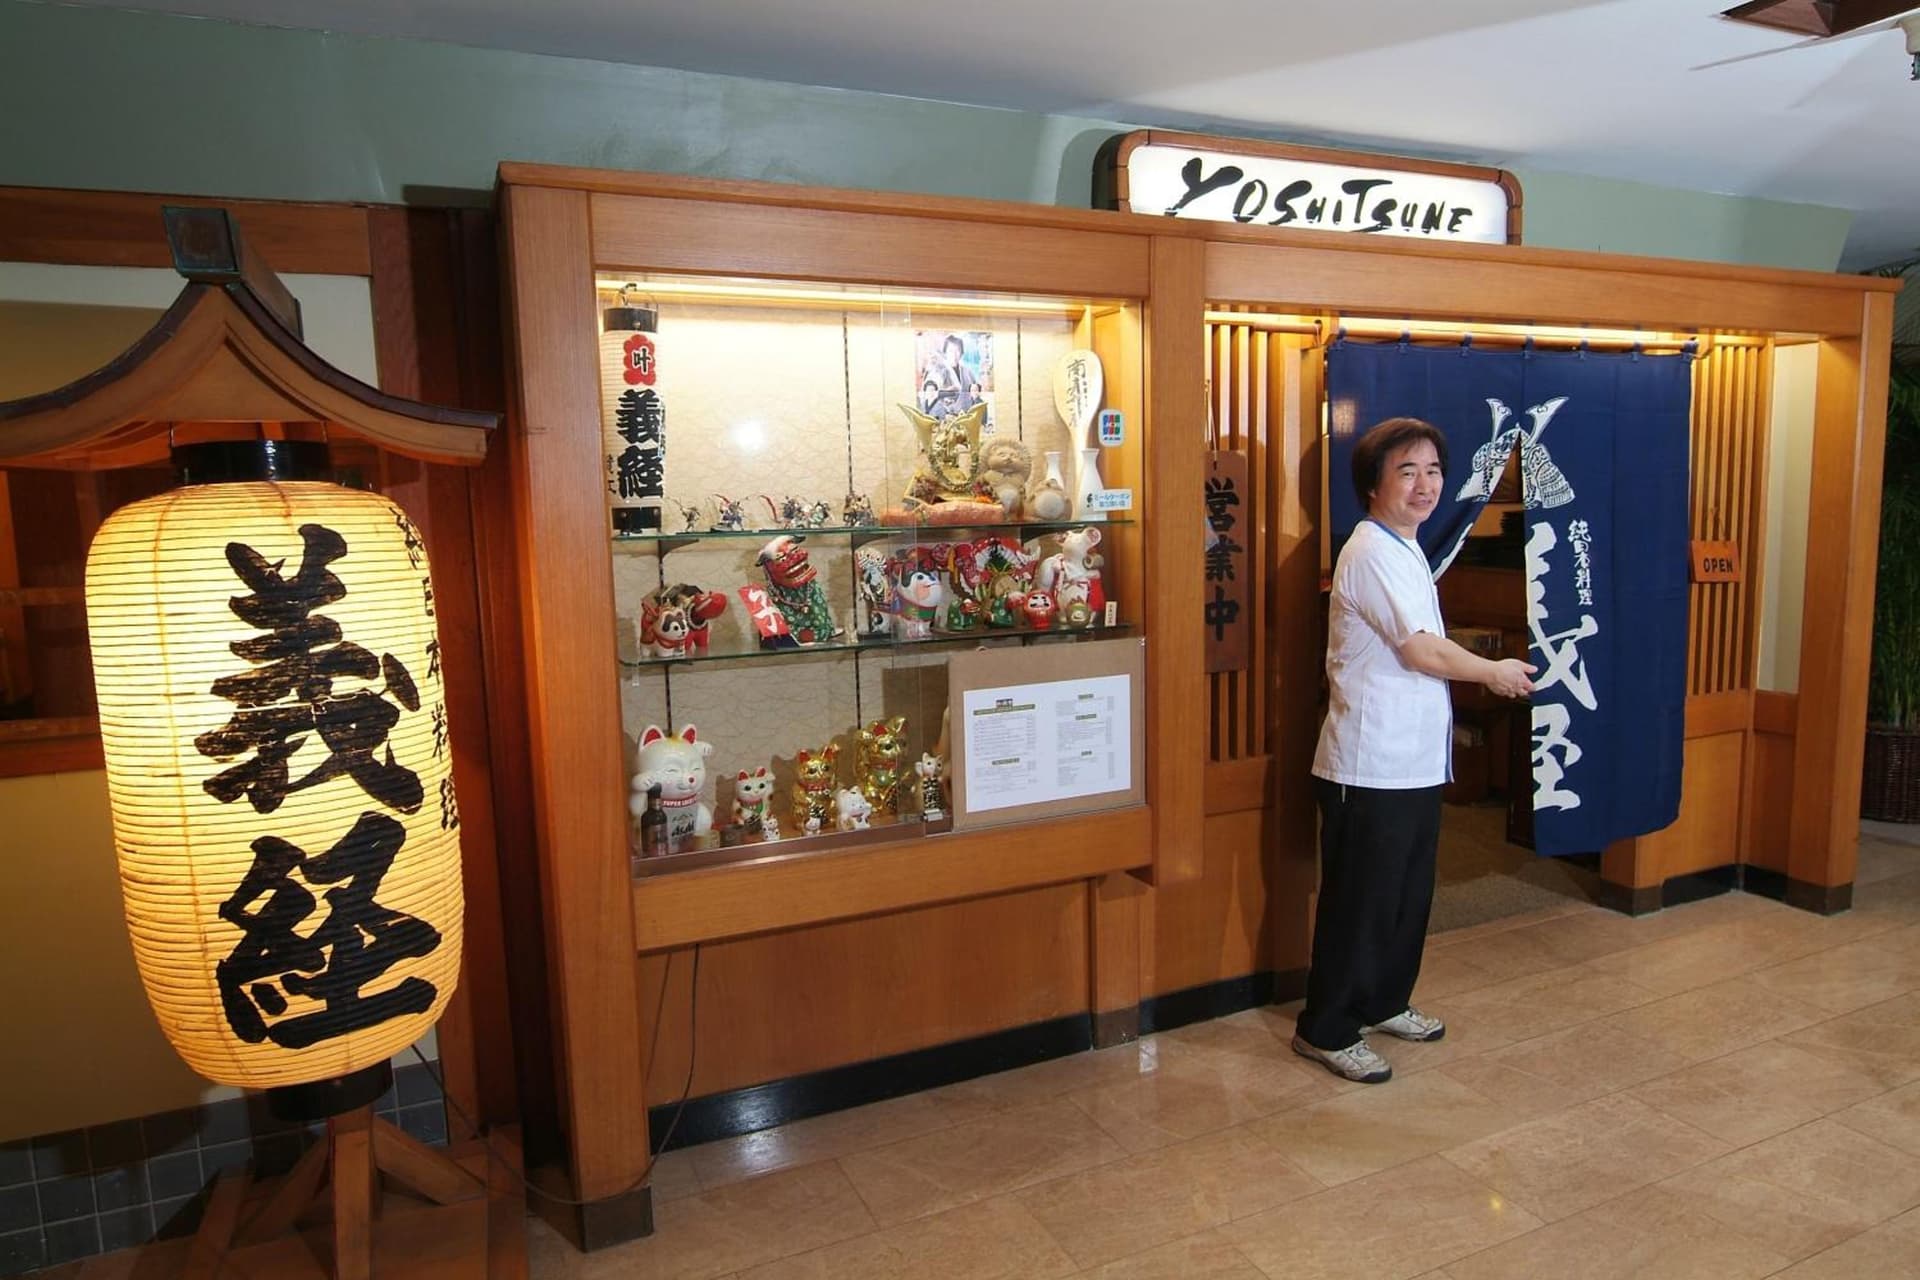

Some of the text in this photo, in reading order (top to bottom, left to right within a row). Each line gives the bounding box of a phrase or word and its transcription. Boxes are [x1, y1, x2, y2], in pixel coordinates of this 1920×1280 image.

[1164, 157, 1473, 234] YOSHITSUNE
[633, 348, 651, 373] 叶
[1204, 477, 1243, 641] 営業中
[1567, 518, 1593, 606] 純日本料理
[1703, 557, 1733, 573] OPEN
[194, 523, 442, 1049] 義経
